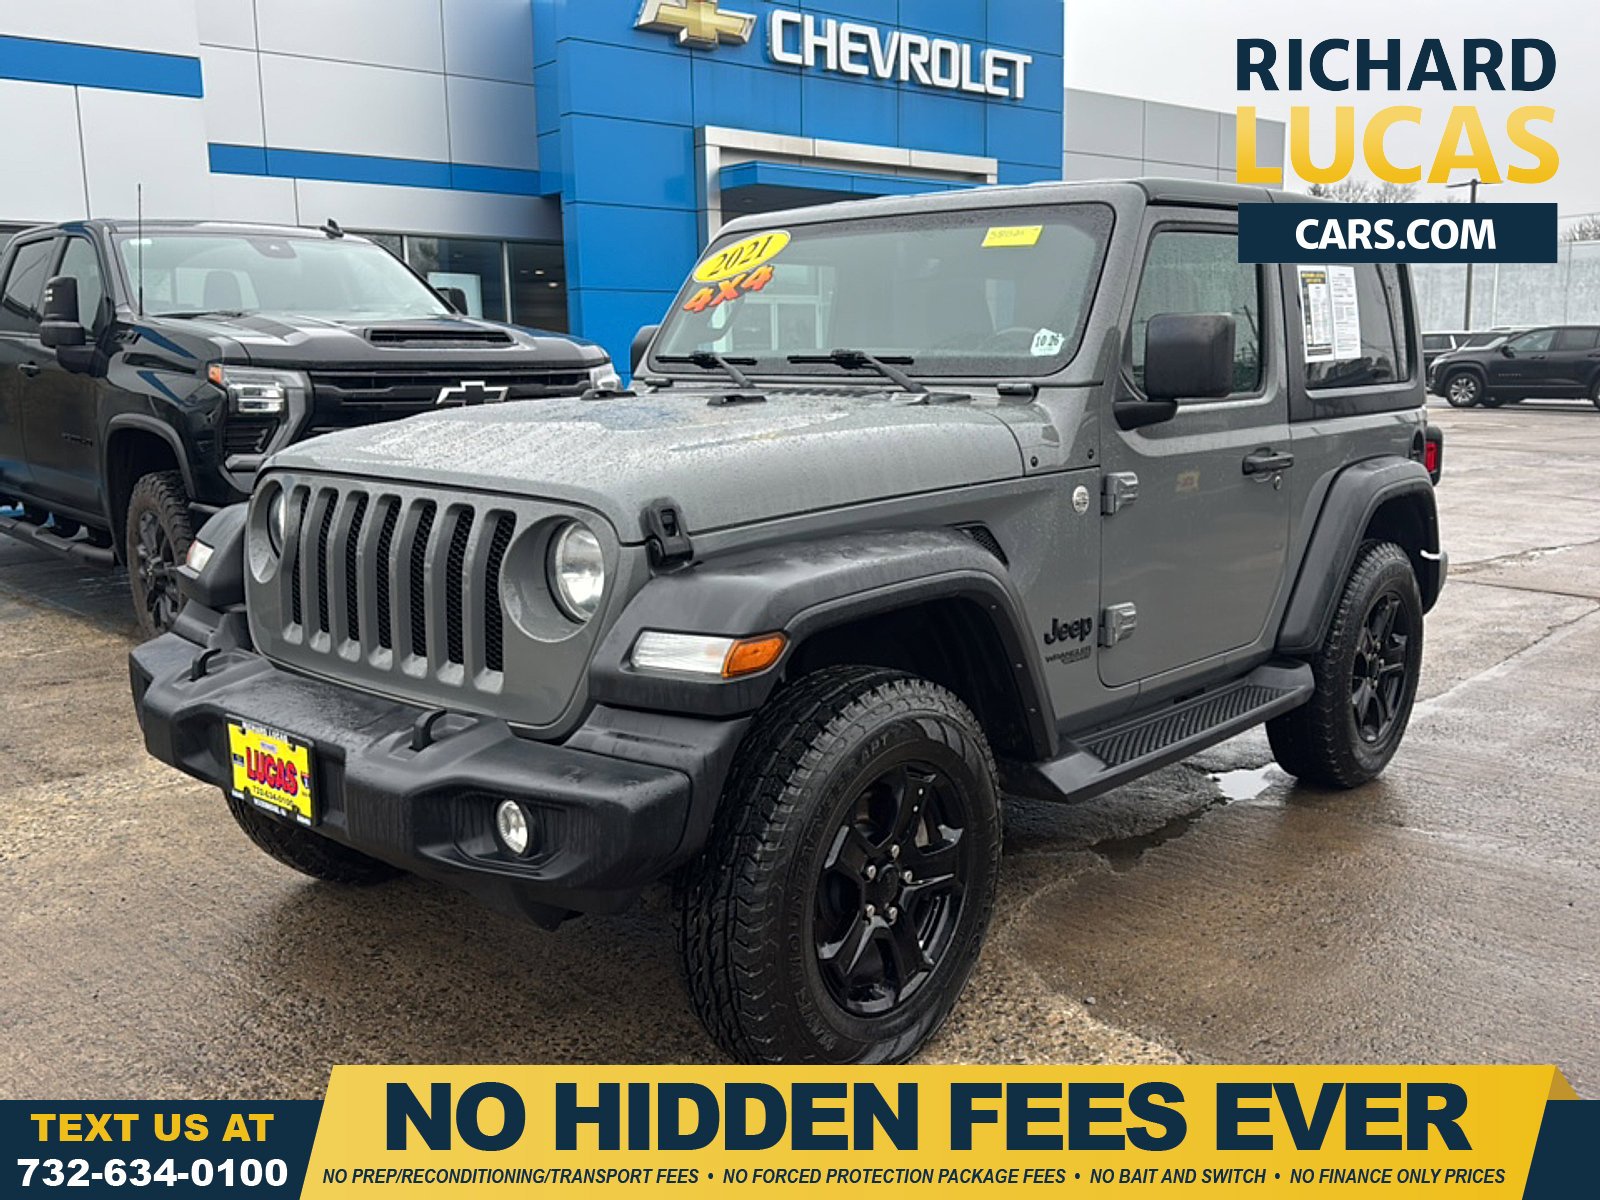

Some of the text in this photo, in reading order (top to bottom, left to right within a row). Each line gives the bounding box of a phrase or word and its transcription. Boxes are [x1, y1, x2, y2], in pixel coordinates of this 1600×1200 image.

[770, 9, 1032, 99] CHEVROLET
[707, 234, 774, 278] 2021
[1043, 616, 1093, 646] Jeep
[246, 746, 299, 796] LUCAS
